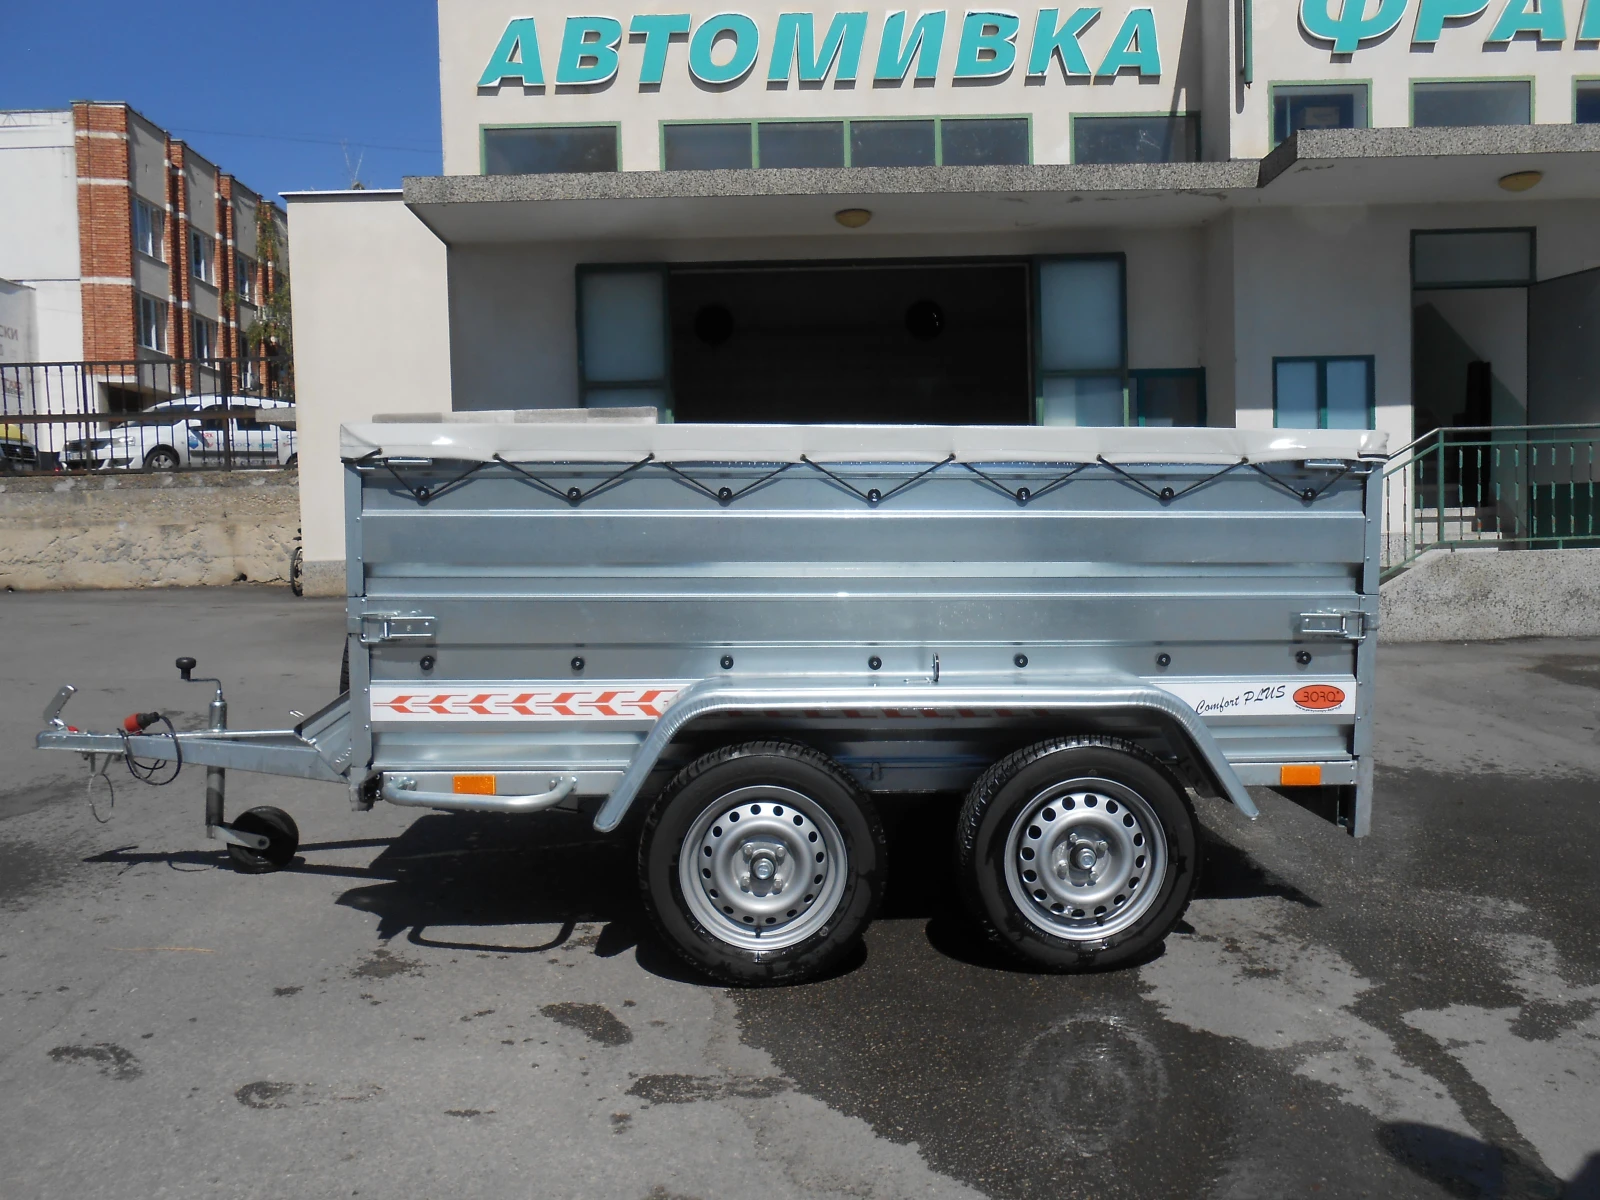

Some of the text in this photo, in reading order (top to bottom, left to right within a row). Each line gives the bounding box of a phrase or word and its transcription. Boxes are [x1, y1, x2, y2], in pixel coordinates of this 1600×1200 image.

[478, 7, 1162, 87] АВТОМИВКА
[1195, 685, 1286, 715] Comfort PLUS
